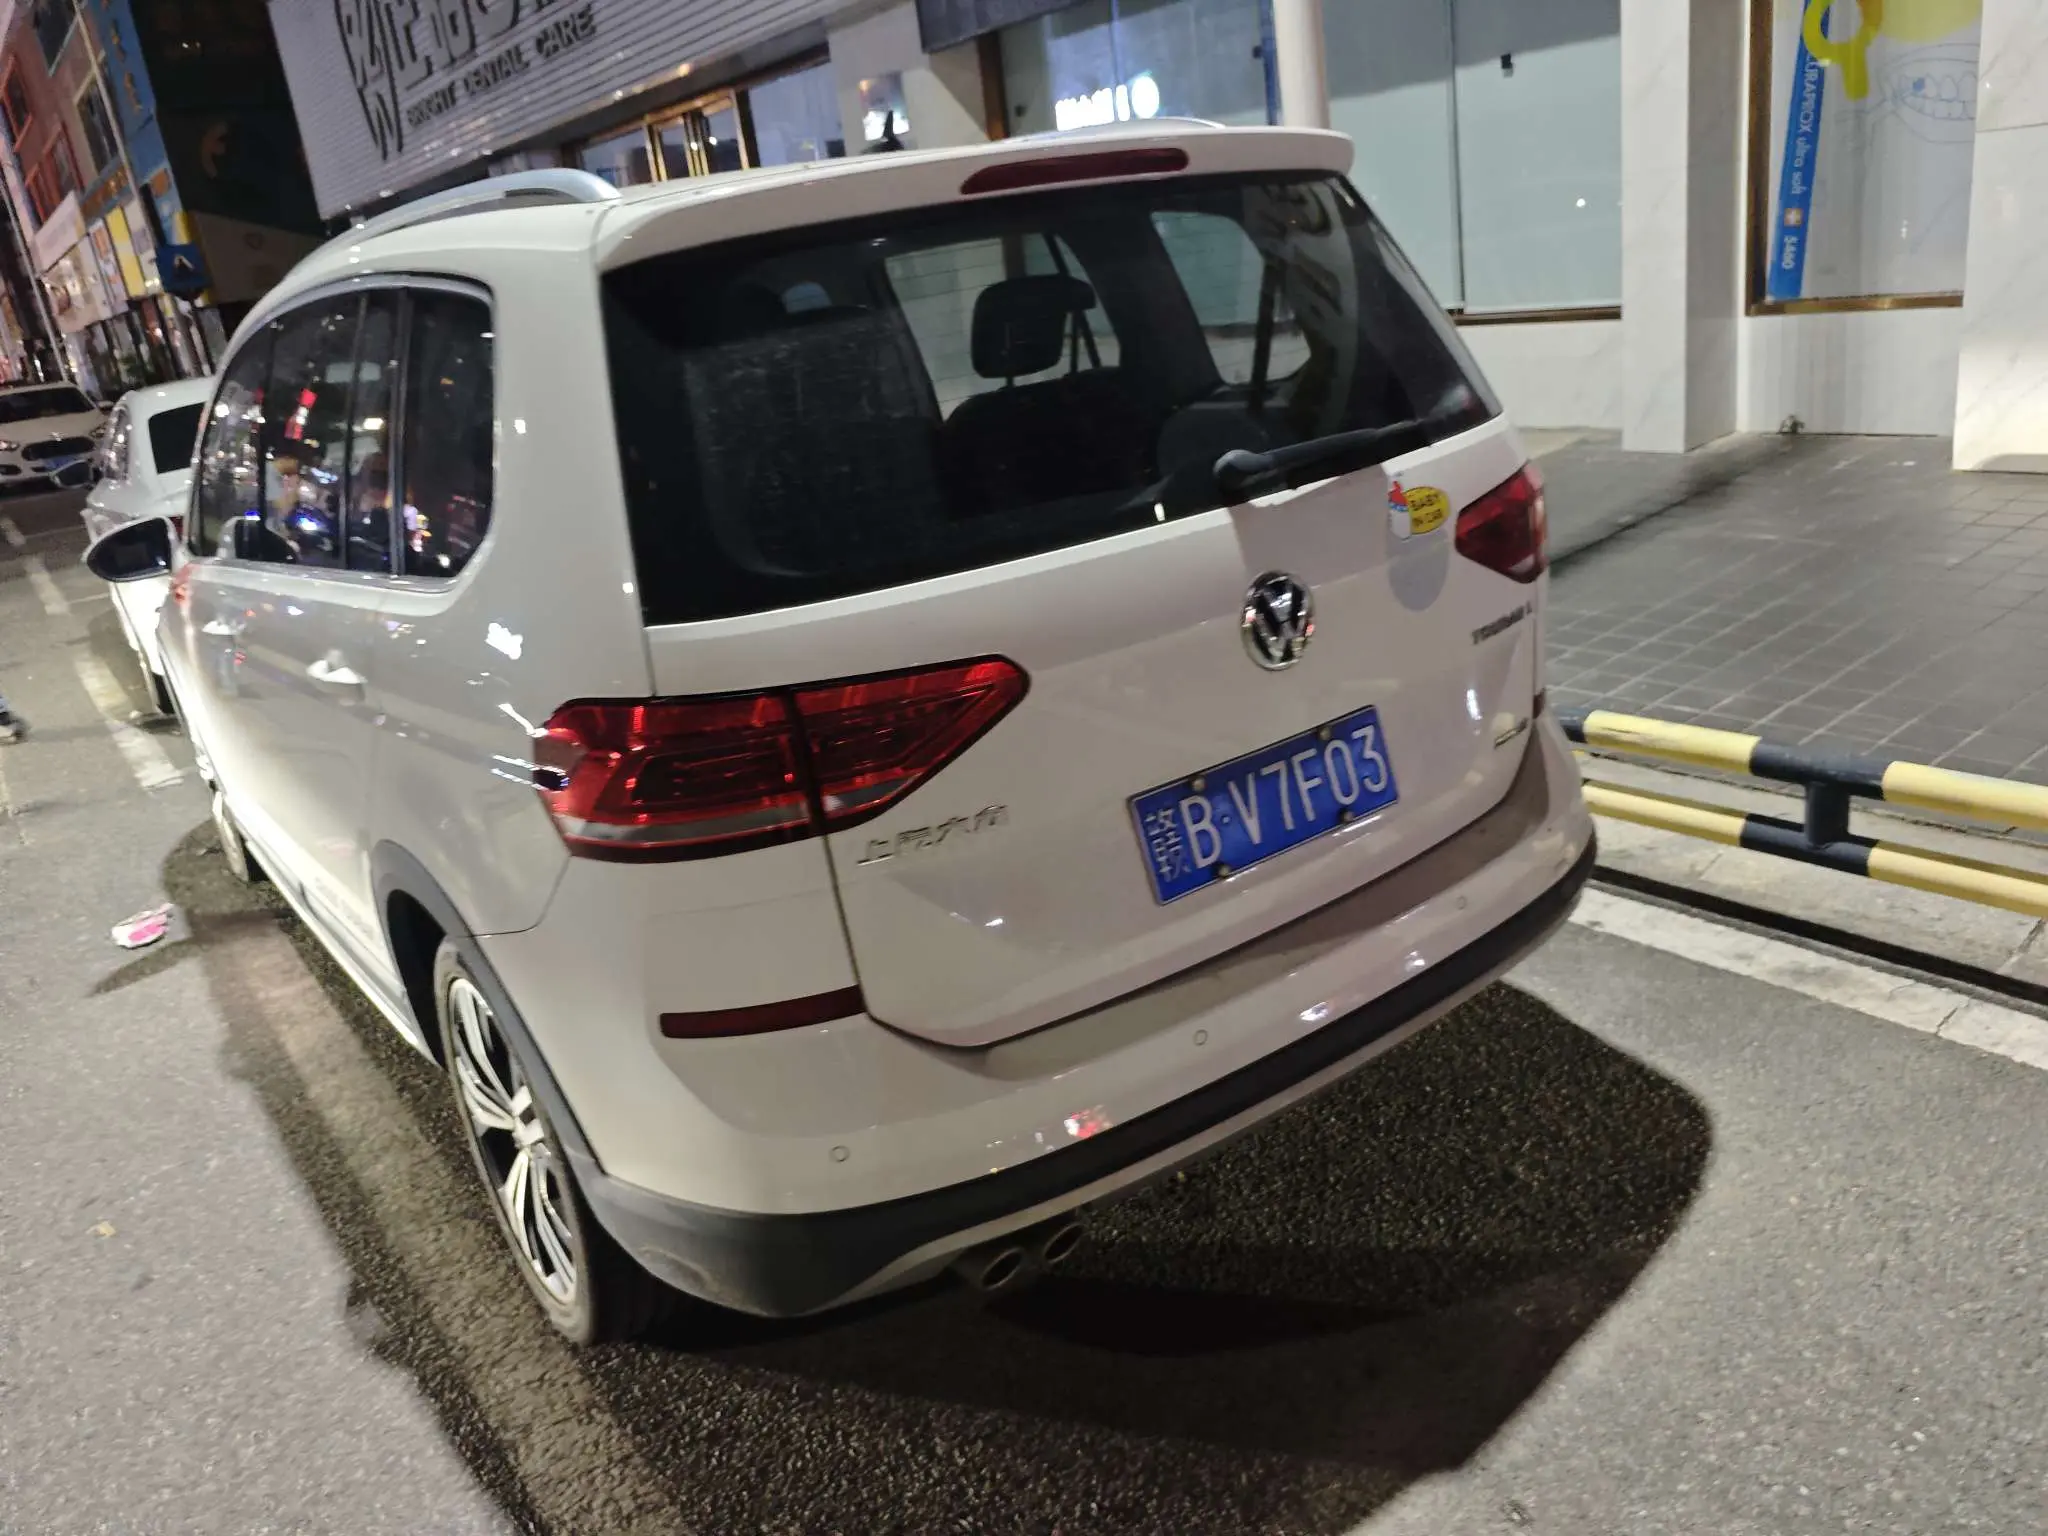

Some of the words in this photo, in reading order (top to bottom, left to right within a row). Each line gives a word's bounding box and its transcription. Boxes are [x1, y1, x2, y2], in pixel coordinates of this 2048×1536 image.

[463, 45, 530, 97] DENTAL
[536, 4, 597, 58] CARE
[1794, 136, 1812, 167] ultra
[1791, 172, 1808, 195] soft
